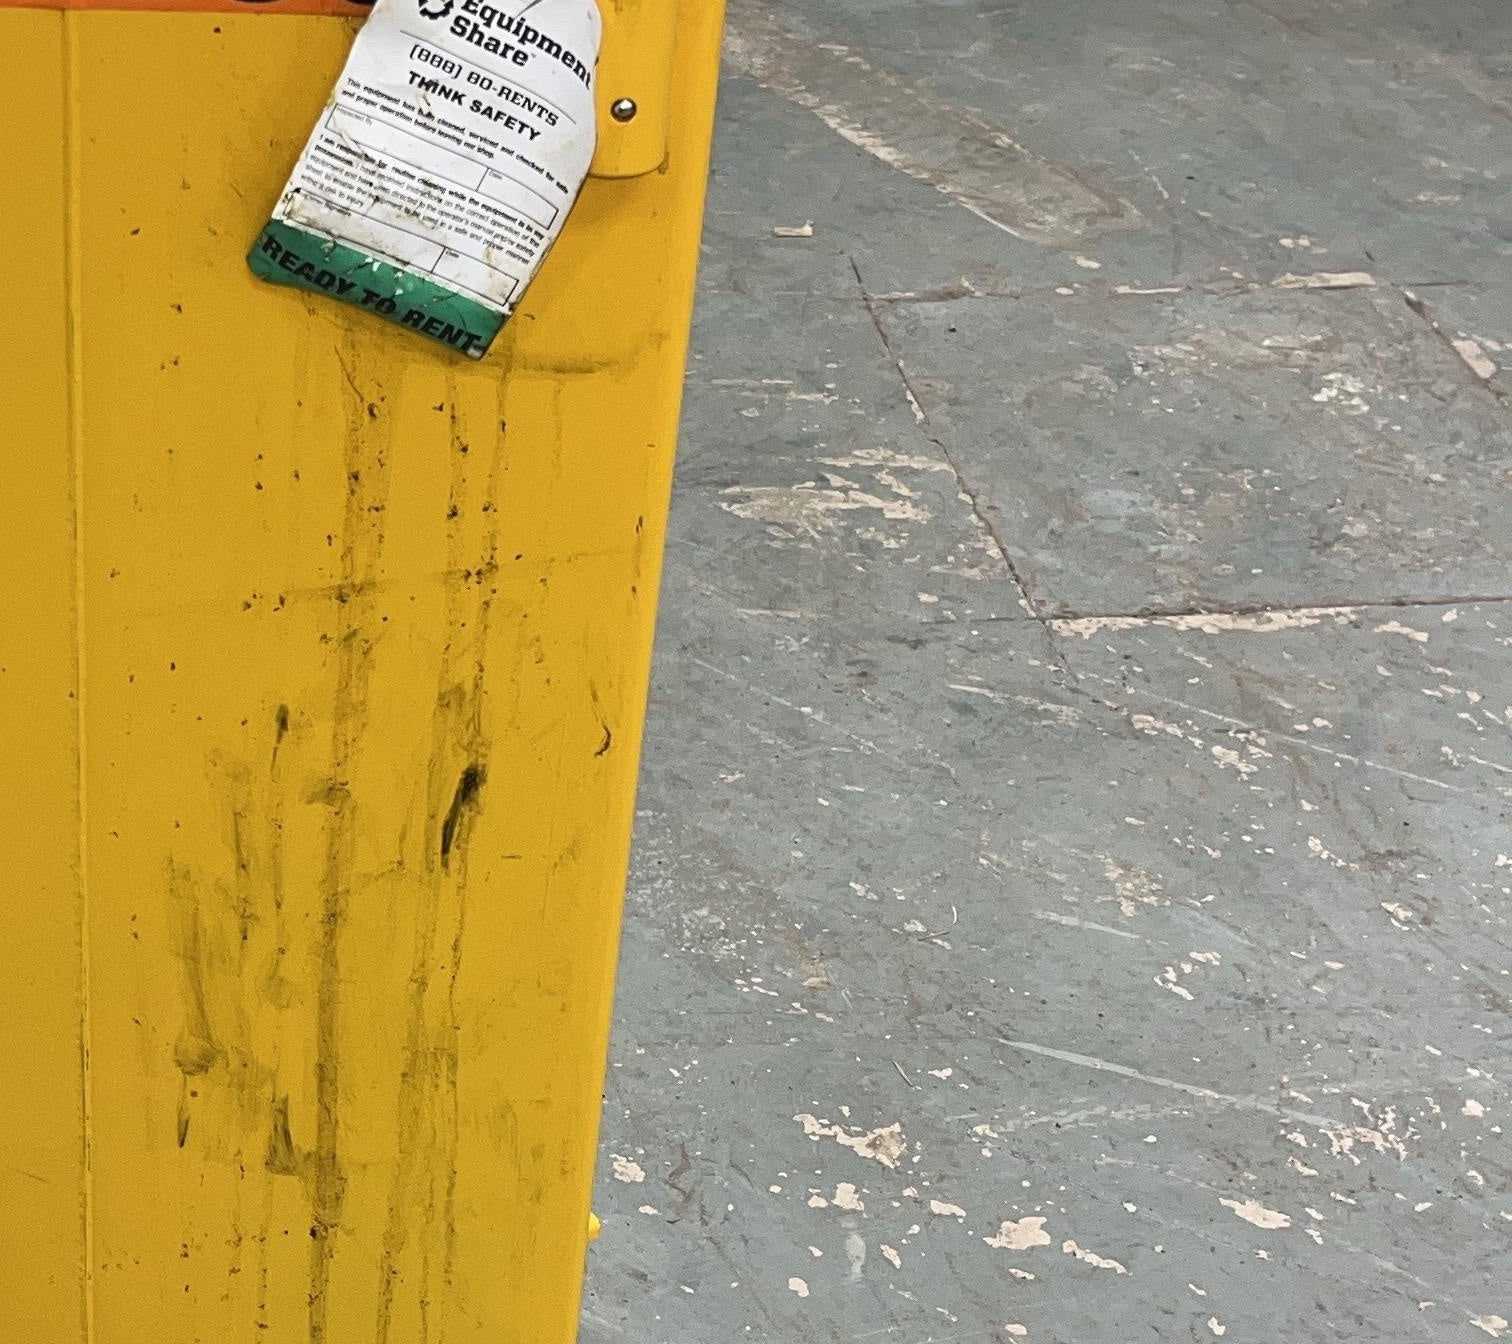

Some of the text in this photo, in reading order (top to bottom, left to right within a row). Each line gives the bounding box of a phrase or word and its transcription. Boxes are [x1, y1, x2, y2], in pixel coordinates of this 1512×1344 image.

[449, 15, 529, 67] Share
[408, 70, 541, 142] THINK SAFETY
[409, 43, 560, 127] (888) 80-RENTS
[261, 234, 482, 352] READY TO RENT
